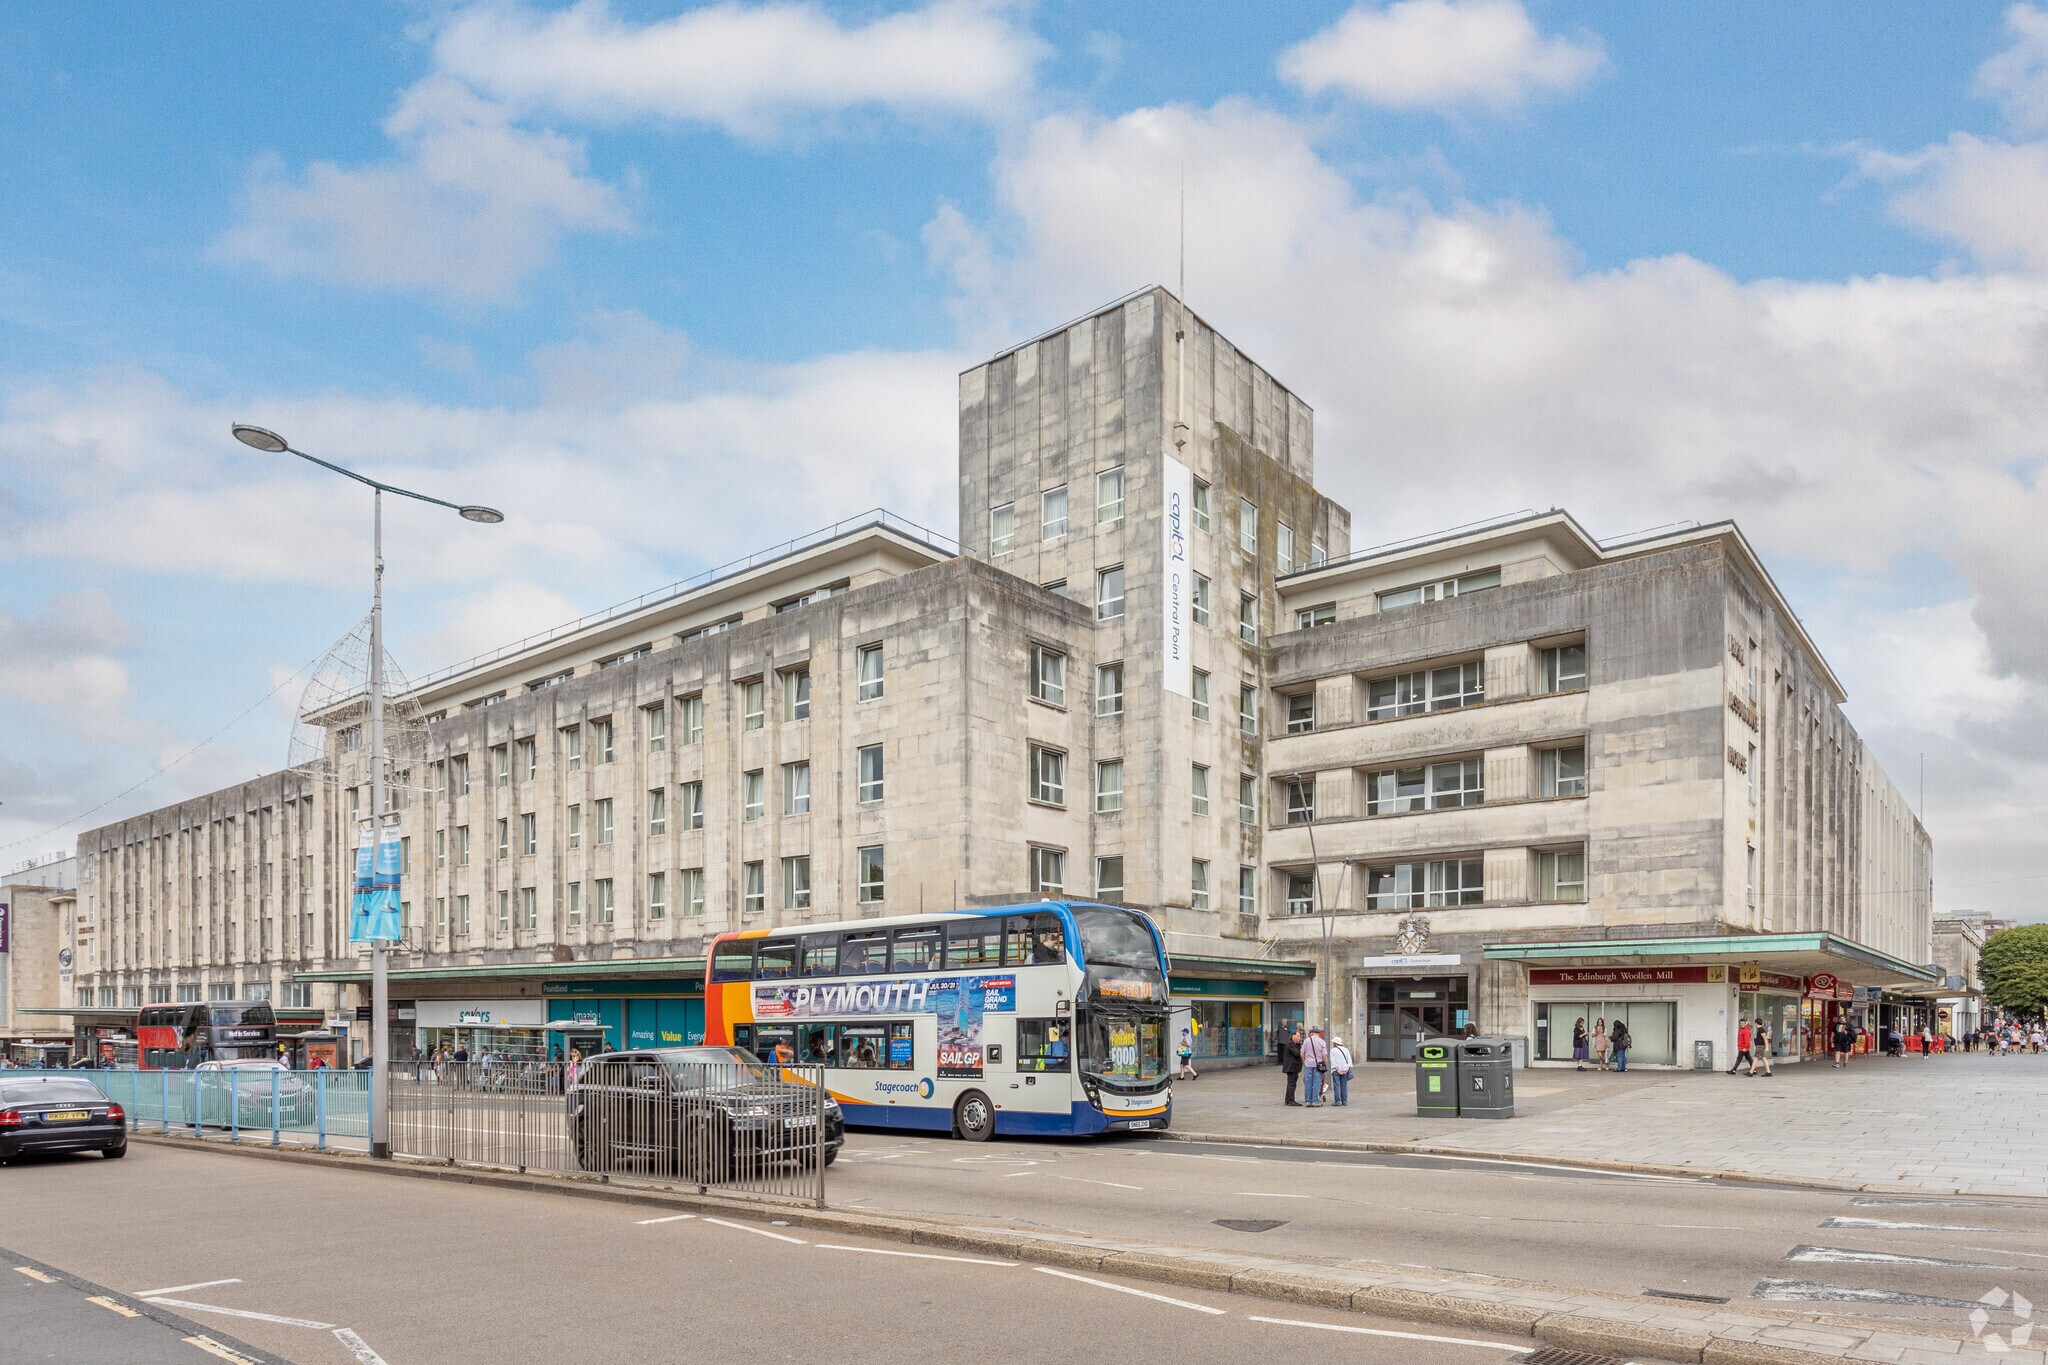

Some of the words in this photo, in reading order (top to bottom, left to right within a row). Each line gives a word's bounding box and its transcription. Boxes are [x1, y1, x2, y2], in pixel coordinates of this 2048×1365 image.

[1169, 492, 1184, 562] capitol
[1172, 573, 1180, 625] Central
[1171, 628, 1180, 660] Point
[1728, 745, 1747, 774] HOUSE
[1577, 972, 1617, 982] Edinburgh
[1620, 971, 1652, 980] Woollen
[1656, 971, 1673, 979] Mill
[796, 982, 929, 1012] PLYMOUTH
[985, 989, 999, 997] SAIL
[1140, 981, 1152, 998] 101
[632, 1030, 654, 1041] Amazing
[661, 1030, 682, 1041] Value
[1112, 1033, 1136, 1046] FRIENDS
[1112, 1047, 1136, 1066] FOOD
[875, 1081, 919, 1094] Stagecoach
